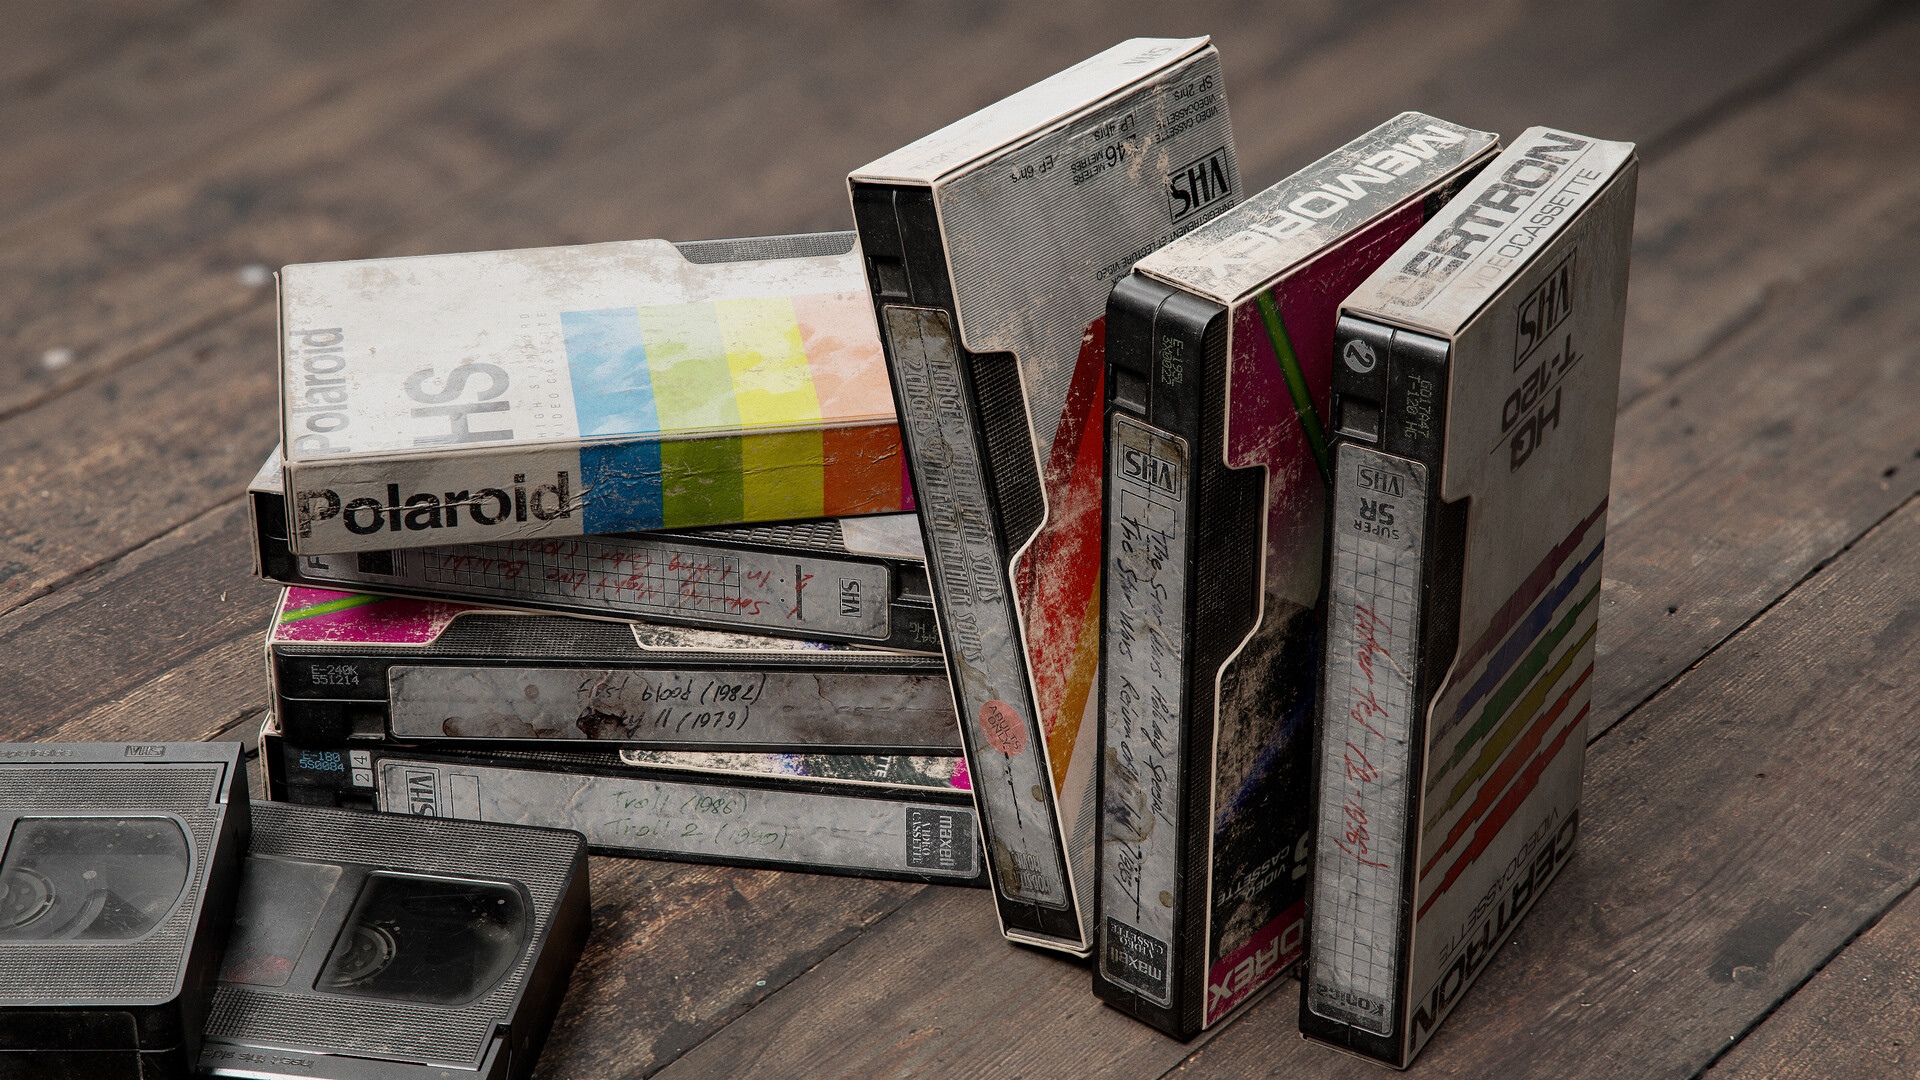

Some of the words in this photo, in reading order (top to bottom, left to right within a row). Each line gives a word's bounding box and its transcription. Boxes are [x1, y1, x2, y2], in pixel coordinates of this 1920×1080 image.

[1199, 75, 1213, 92] SP
[1120, 114, 1136, 132] LP
[1155, 118, 1193, 144] CASSETTE
[1196, 106, 1218, 123] VIDEO
[1071, 151, 1103, 174] METRES
[1073, 161, 1106, 186] METERS
[1170, 156, 1229, 217] VHS
[1204, 124, 1467, 279] MEMOREX
[1377, 133, 1588, 308] CERTRON
[1460, 168, 1602, 293] VIDEOCASSETTE
[1519, 265, 1568, 361] VHS
[1346, 345, 1375, 368] 2
[294, 326, 351, 456] Polaroid
[1501, 333, 1576, 434] T-120
[404, 361, 513, 446] HS
[533, 402, 547, 438] HIGH
[549, 393, 564, 437] VIDEO
[1511, 386, 1561, 474] HG
[1126, 450, 1173, 490] VHS
[1360, 469, 1401, 496] VHS
[299, 470, 573, 539] Polaroid
[1359, 497, 1395, 526] SR
[1120, 516, 1142, 553] The
[1353, 519, 1400, 540] SUPER
[1151, 530, 1169, 570] The
[747, 571, 771, 588] In
[969, 551, 1001, 604] SOULS
[1117, 558, 1138, 608] Star
[842, 580, 860, 614] VHS
[1150, 577, 1167, 625] Star
[909, 622, 926, 634] HG
[953, 610, 985, 662] SOULS
[1118, 610, 1136, 662] Wars
[311, 664, 359, 675] E-240K
[312, 674, 360, 685] 551214
[700, 674, 766, 705] (1982)
[676, 705, 749, 733] (1979)
[989, 704, 1021, 750] ADULTS
[354, 755, 368, 765] 4
[355, 773, 370, 783] 2
[408, 775, 434, 816] VHS
[608, 791, 670, 813] Troll
[604, 818, 670, 837] Troll
[681, 823, 703, 838] 2
[912, 811, 923, 864] CASSETTE
[922, 822, 933, 856] VIDEO
[939, 815, 955, 866] maxell
[1217, 845, 1291, 907] CASSETTE
[1246, 863, 1287, 902] VIDEO
[1438, 806, 1560, 969] VIDEOCASSETTE
[1110, 921, 1164, 955] CASSETTE
[1119, 936, 1155, 959] VIDEO
[1410, 808, 1578, 1053] CERTRON
[1111, 946, 1163, 981] maxell
